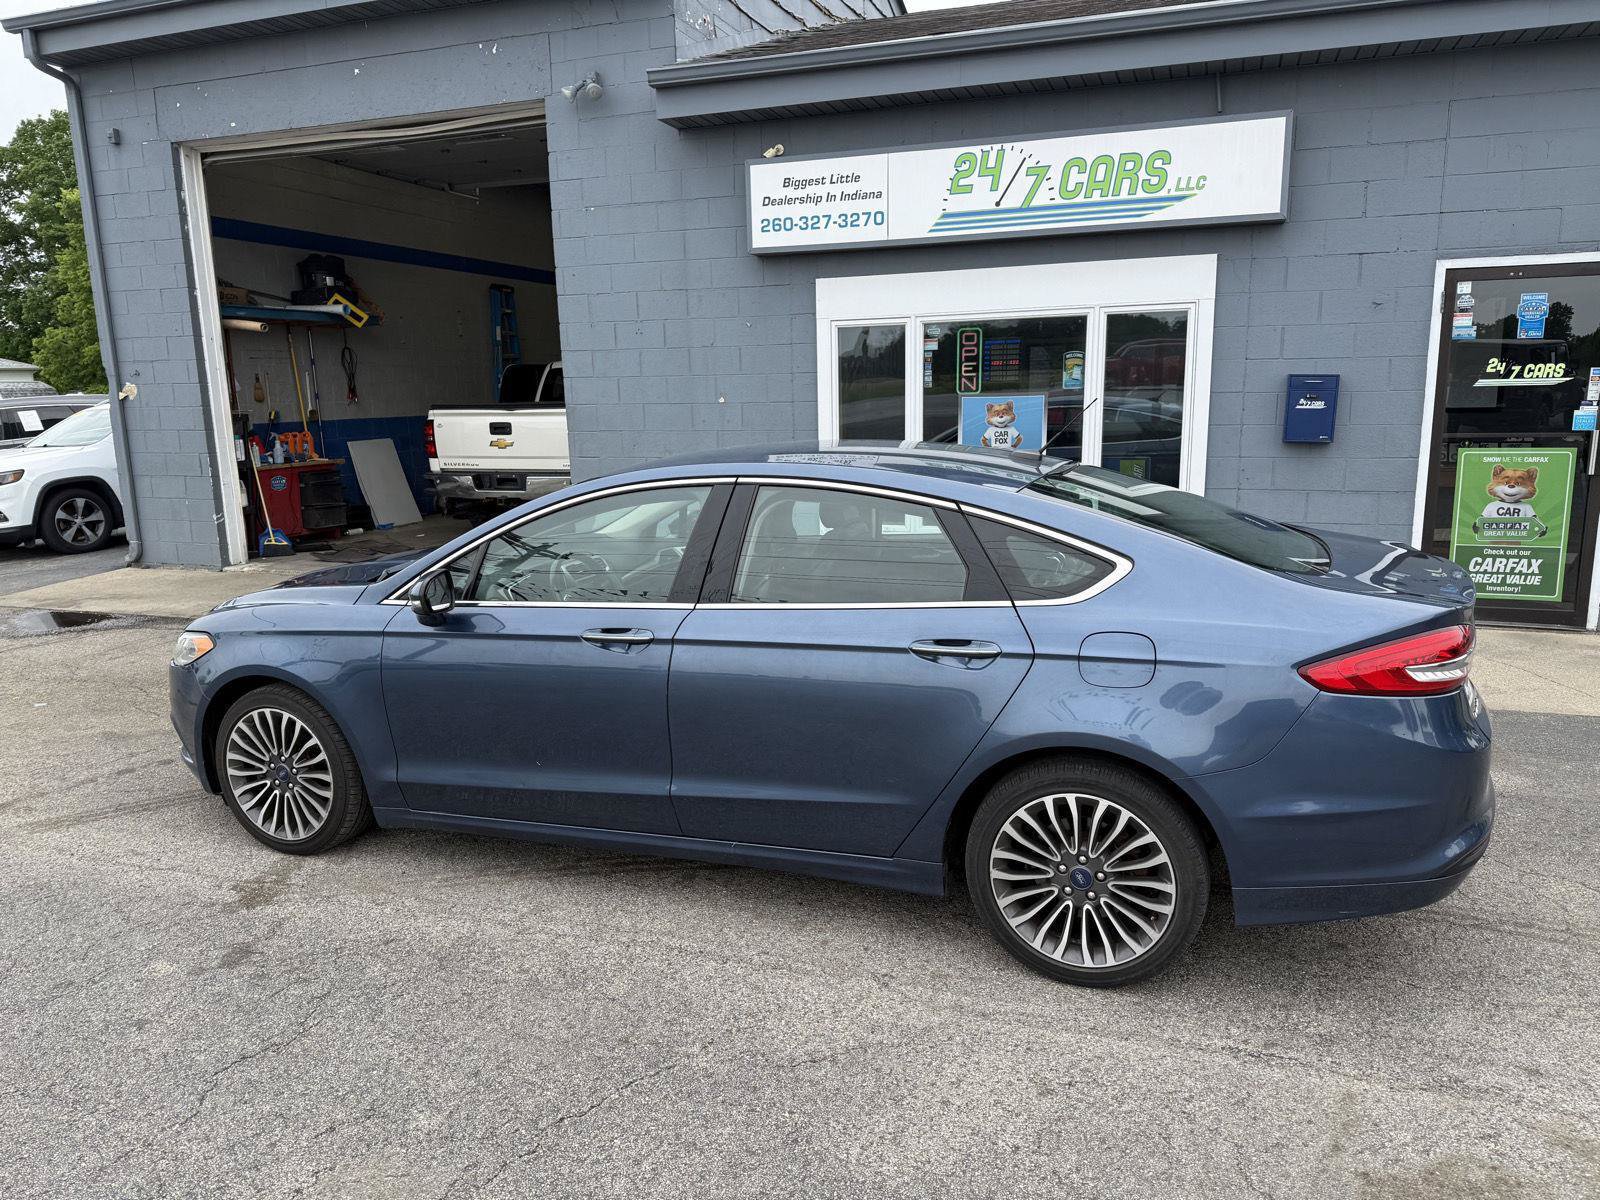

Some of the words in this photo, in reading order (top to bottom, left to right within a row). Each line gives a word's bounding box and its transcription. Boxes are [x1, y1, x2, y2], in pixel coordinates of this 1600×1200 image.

[782, 175, 827, 190] Biggest
[829, 172, 861, 185] Little
[1174, 174, 1208, 193] LLC
[762, 192, 823, 207] Dealership
[825, 191, 837, 203] In
[839, 189, 883, 202] Indiana
[760, 210, 885, 233] 260-327-3270
[961, 332, 978, 391] OPEN
[1523, 362, 1566, 378] CARS
[993, 430, 1009, 438] CAR
[994, 437, 1008, 445] FOX
[1496, 506, 1521, 517] CAR
[1483, 522, 1530, 530] CARFAX
[1483, 548, 1505, 556] Check
[1468, 556, 1543, 574] CARFAX
[1469, 573, 1505, 584] GREAT
[1506, 574, 1542, 585] VALUE
[1486, 584, 1521, 594] Inventory!
